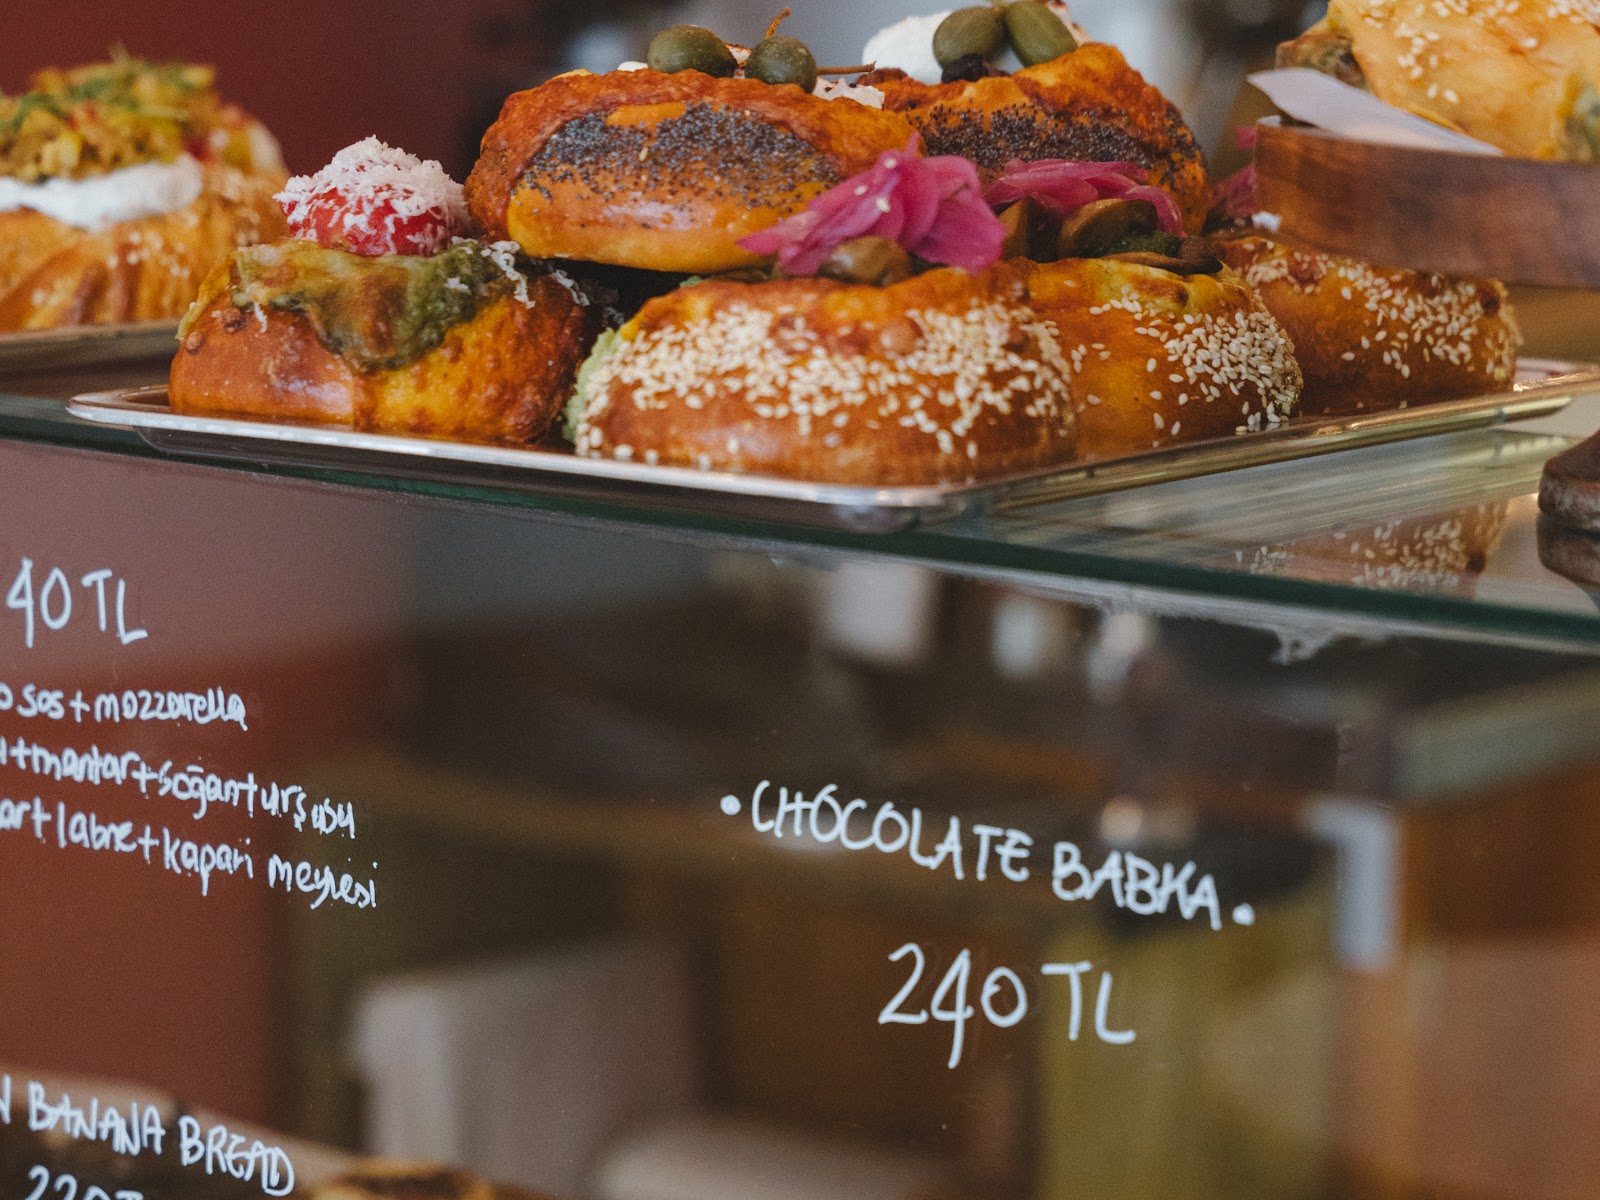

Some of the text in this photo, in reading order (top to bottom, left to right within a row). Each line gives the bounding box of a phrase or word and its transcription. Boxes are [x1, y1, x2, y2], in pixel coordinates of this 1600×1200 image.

[878, 942, 1136, 1069] 240 TL
[27, 1080, 167, 1156] BANANA
[178, 1114, 295, 1197] BREAD
